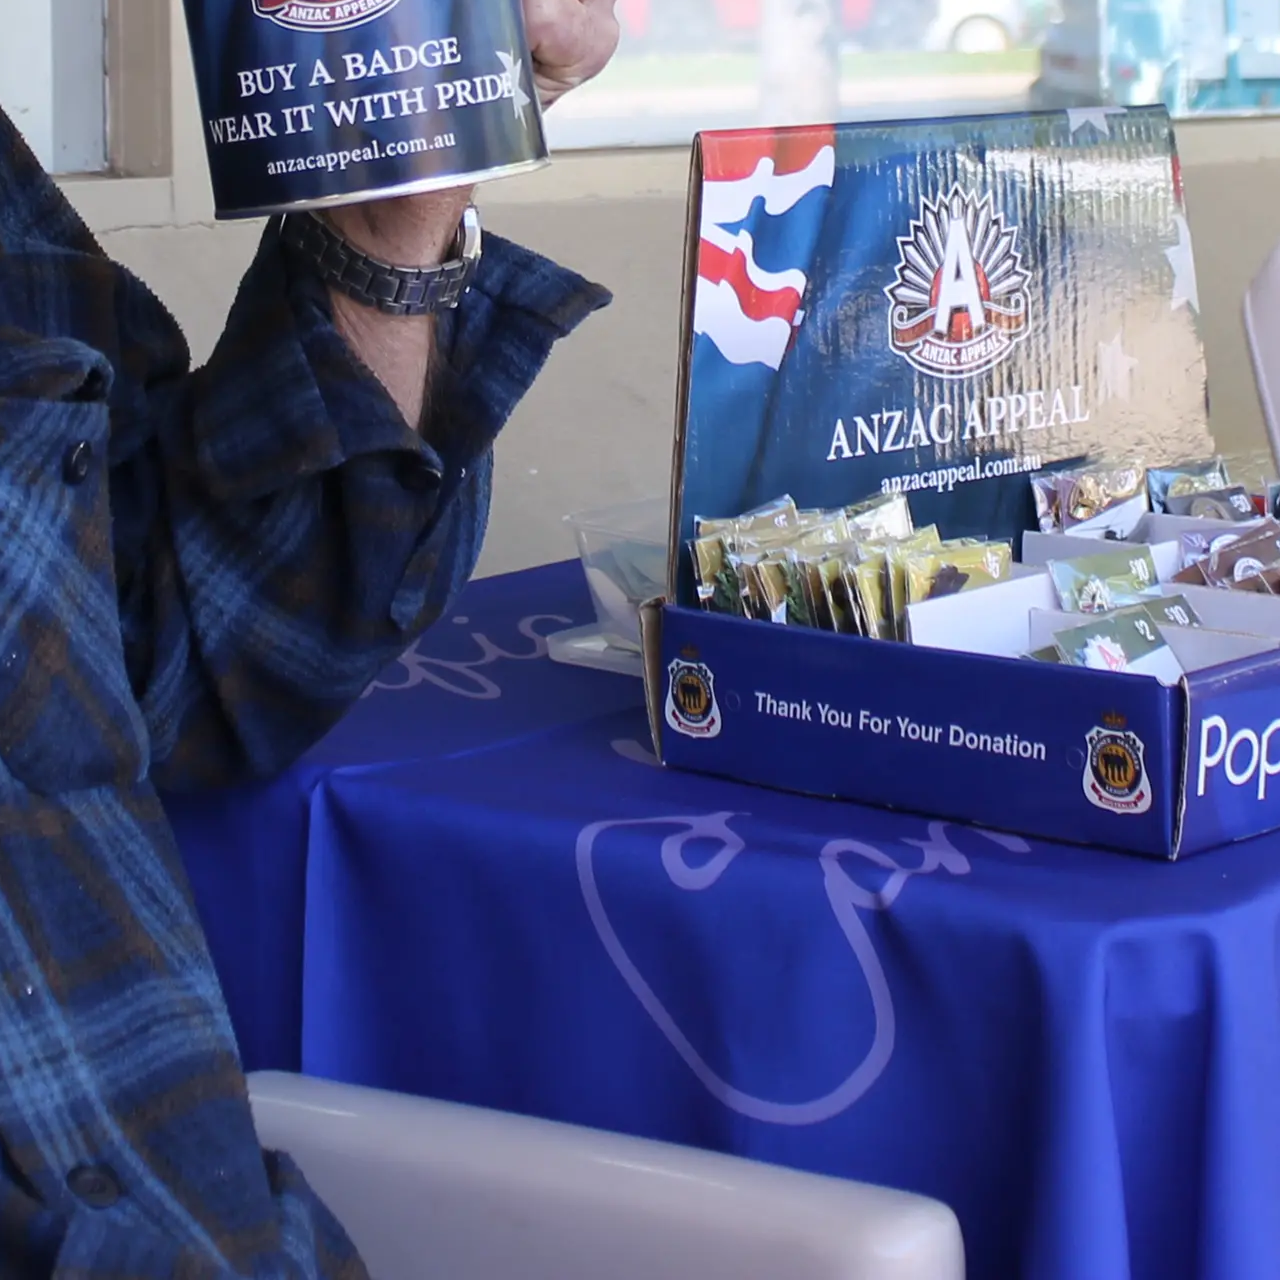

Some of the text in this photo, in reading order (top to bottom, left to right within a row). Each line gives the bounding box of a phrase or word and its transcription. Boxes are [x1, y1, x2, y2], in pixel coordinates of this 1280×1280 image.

[288, 6, 331, 21] ANZAC
[237, 36, 462, 97] BUY A BADGE
[209, 72, 517, 145] WEAR IT WITH PRIDE
[266, 131, 456, 176] anzacappeal.com.au
[921, 333, 1000, 365] ANZAC APPEAL
[825, 384, 1090, 461] ANZAC APPEAL
[880, 453, 1042, 495] anzacappeal.com.au
[1128, 557, 1151, 582] $10
[1134, 619, 1156, 642] $2
[754, 691, 1047, 762] Thank You For Your Donation
